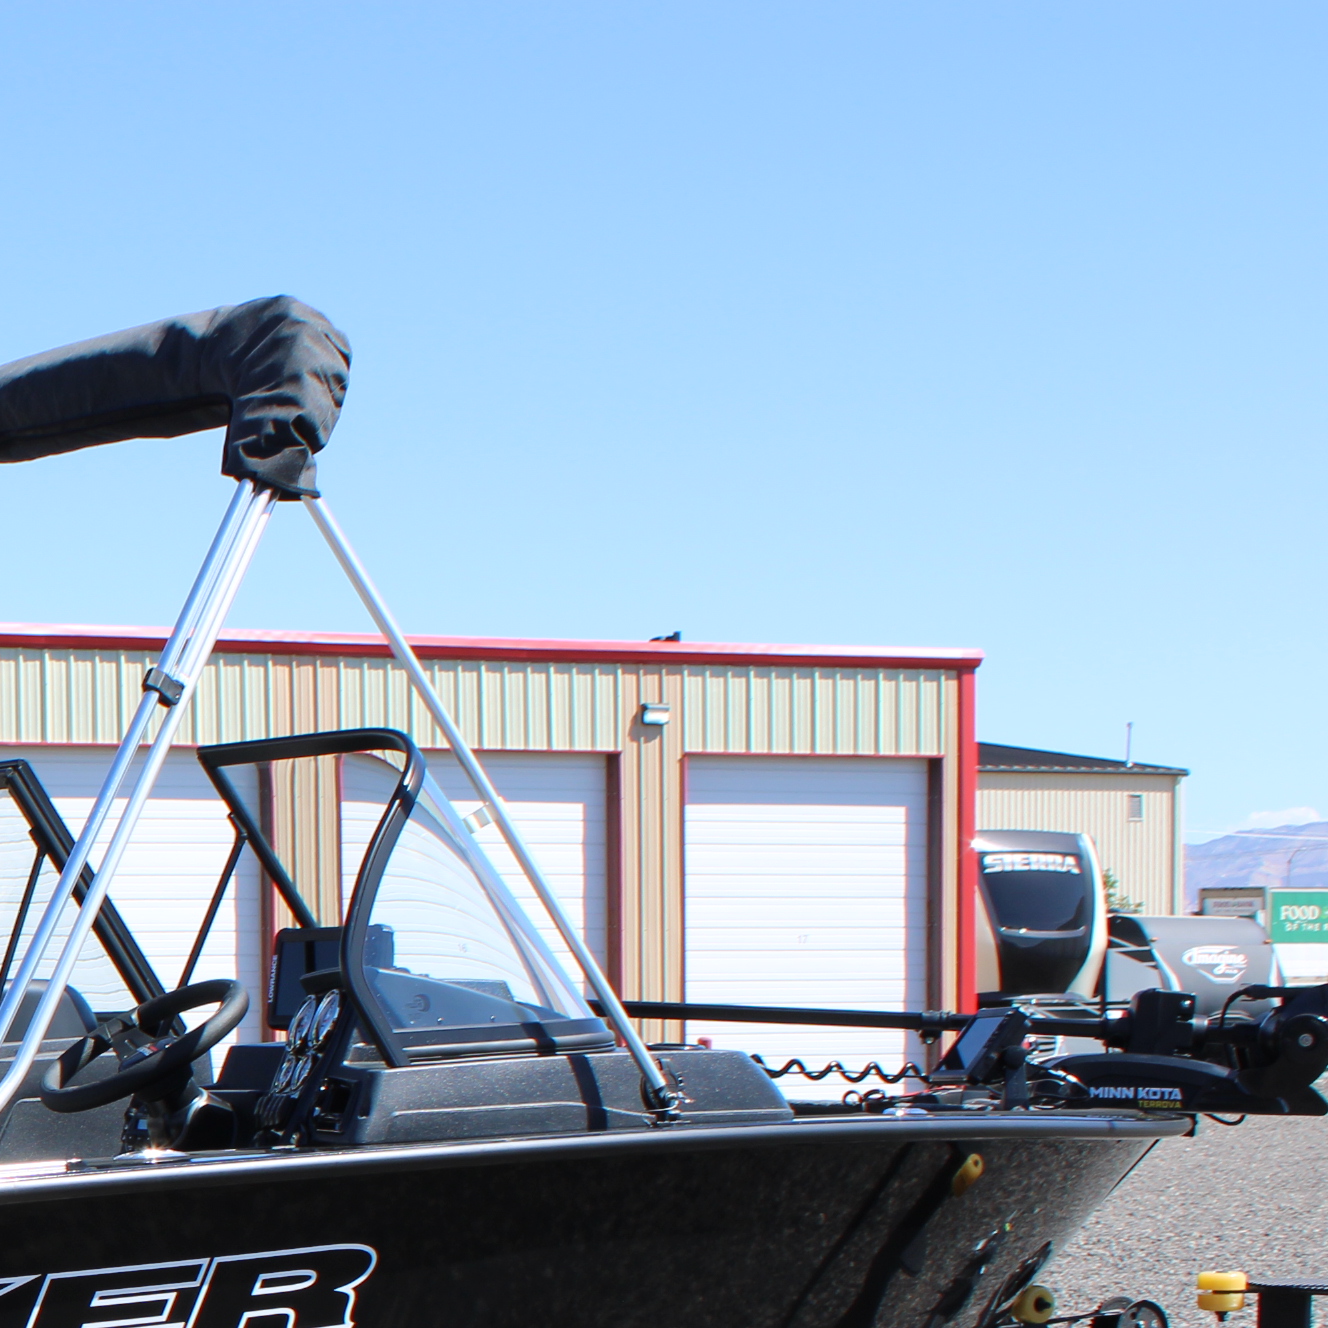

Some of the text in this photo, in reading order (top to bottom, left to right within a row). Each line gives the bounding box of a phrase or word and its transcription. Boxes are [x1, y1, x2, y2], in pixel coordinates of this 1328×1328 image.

[1280, 904, 1320, 920] FOOD
[267, 954, 279, 1003] LOWRANCE
[1089, 1086, 1182, 1100] MINN KOTA
[1138, 1100, 1182, 1109] TERROVA
